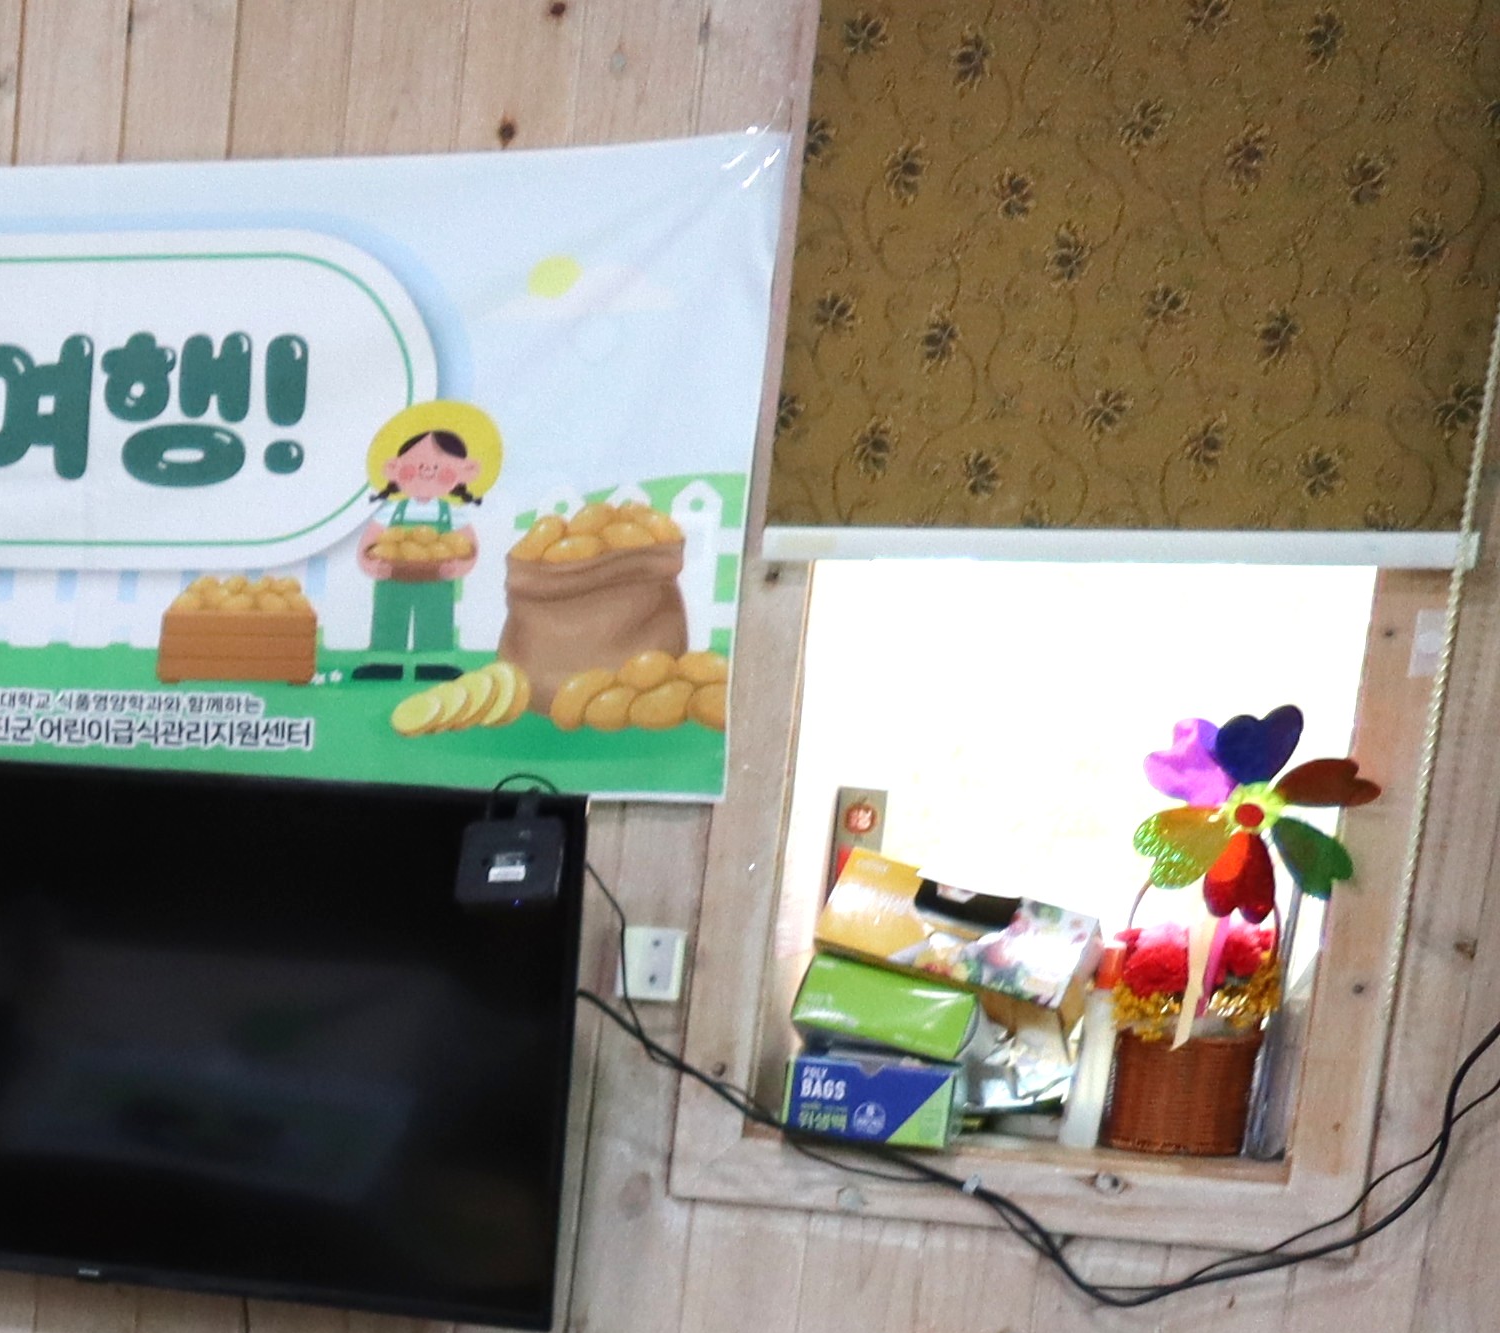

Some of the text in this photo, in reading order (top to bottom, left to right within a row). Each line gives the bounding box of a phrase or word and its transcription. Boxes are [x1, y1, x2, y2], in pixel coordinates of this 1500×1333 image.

[58, 692, 182, 715] 식품영양학과와
[188, 693, 263, 714] 함께하는
[39, 717, 312, 749] 어린이급식관리지원센터
[800, 1078, 847, 1101] BAGS
